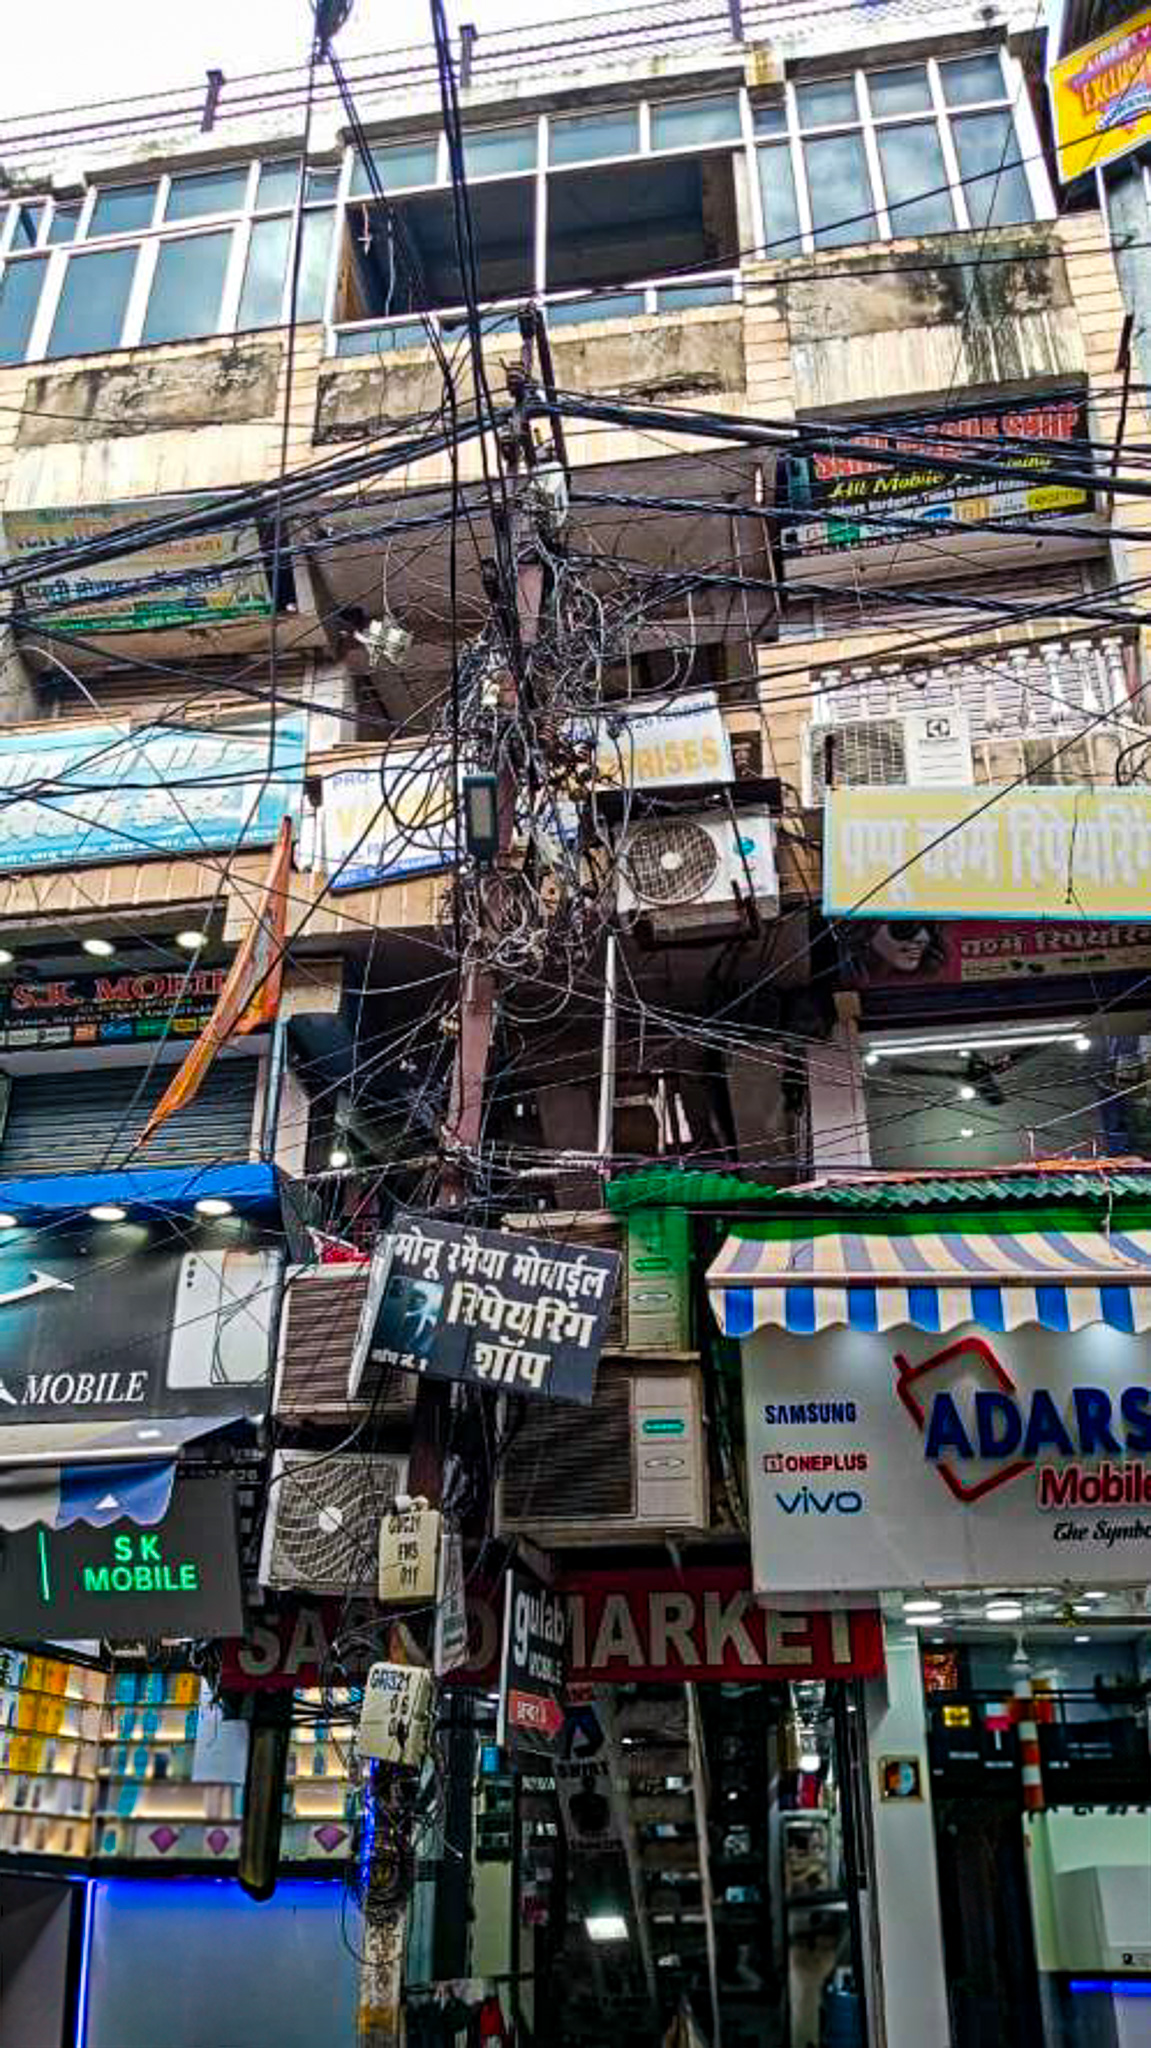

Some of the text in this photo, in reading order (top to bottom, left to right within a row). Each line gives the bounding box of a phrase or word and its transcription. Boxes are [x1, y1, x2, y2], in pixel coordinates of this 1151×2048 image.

[474, 1335, 551, 1389] शॉप
[21, 1371, 149, 1405] MOBILE
[764, 1402, 857, 1425] SAMSUNG
[786, 1452, 868, 1472] ONEPLUS
[776, 1486, 864, 1515] vivo
[1053, 1521, 1091, 1542] The
[114, 1534, 162, 1561] S K
[83, 1564, 198, 1592] MOBILE
[514, 1589, 566, 1667] gulab
